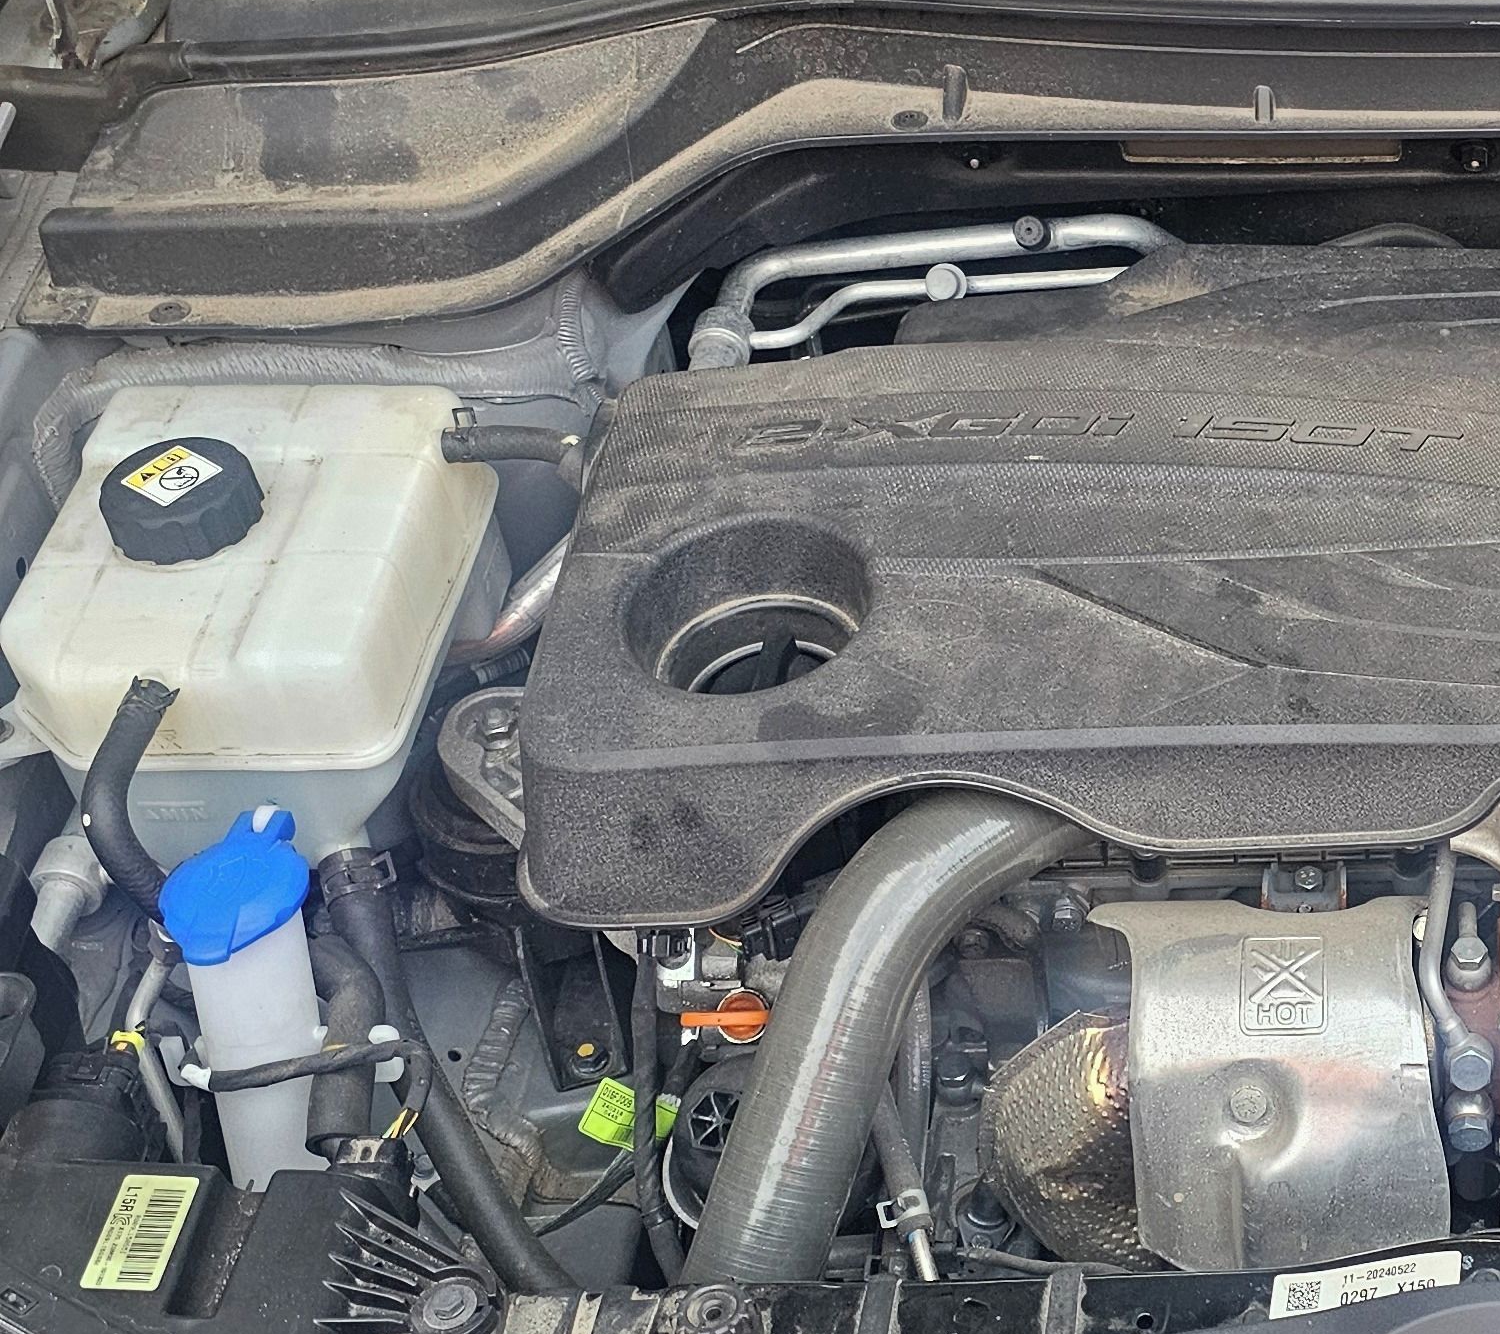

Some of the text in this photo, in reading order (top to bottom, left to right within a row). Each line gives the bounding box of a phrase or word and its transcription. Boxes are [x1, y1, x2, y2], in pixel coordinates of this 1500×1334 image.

[1172, 413, 1465, 453] 150T
[1256, 1001, 1313, 1026] HOT
[118, 1186, 143, 1214] L15R
[1342, 1262, 1417, 1284] 11-20240522
[1340, 1287, 1378, 1305] 0297
